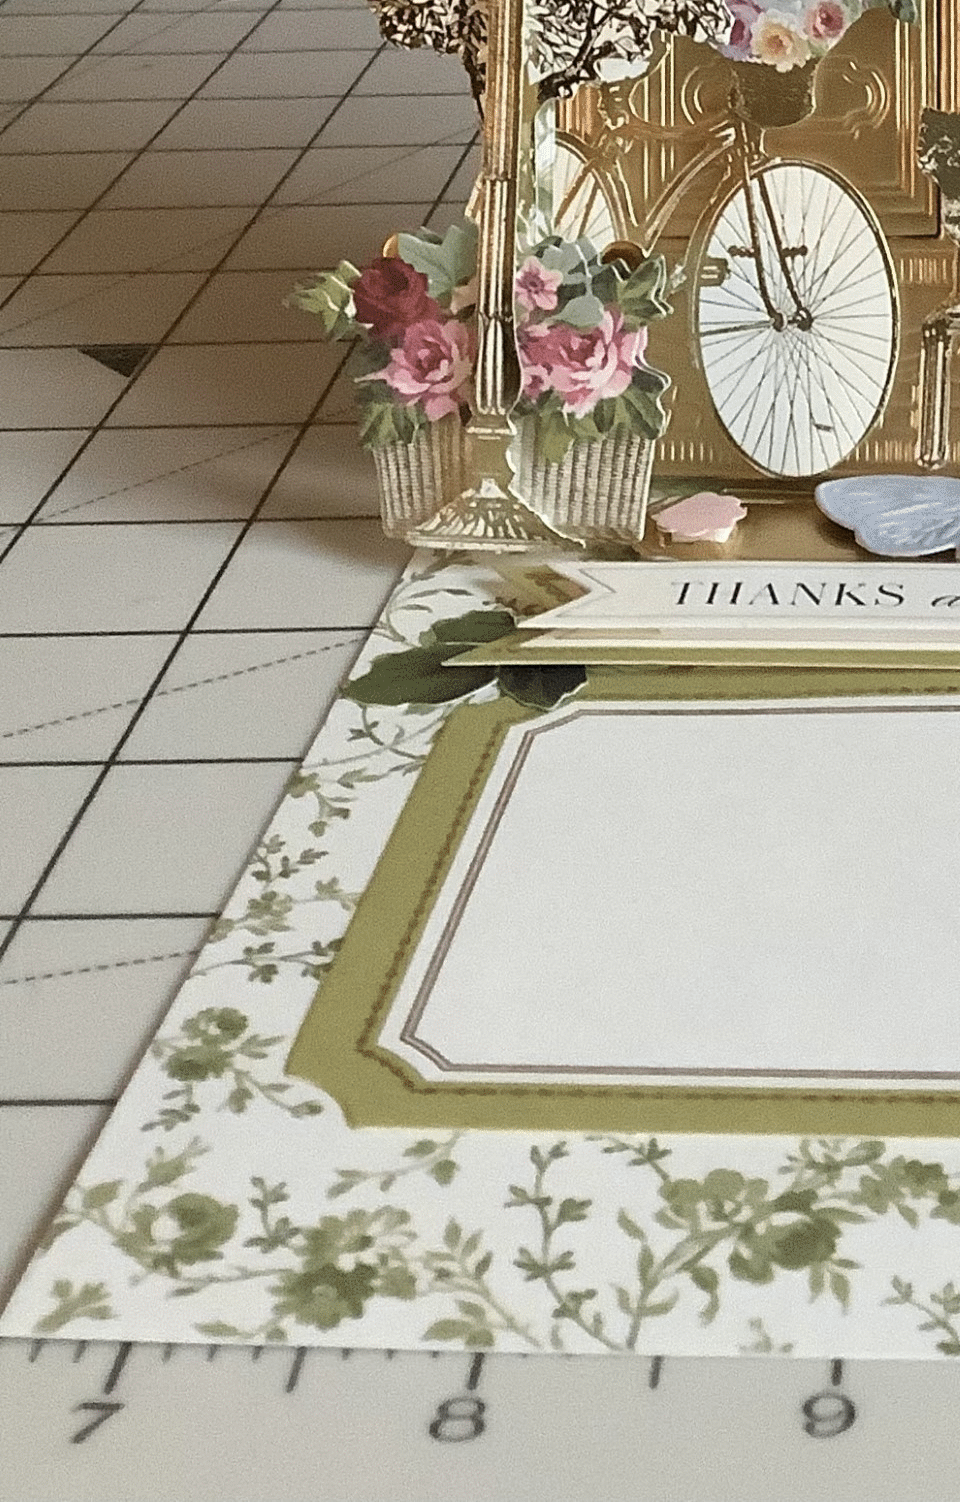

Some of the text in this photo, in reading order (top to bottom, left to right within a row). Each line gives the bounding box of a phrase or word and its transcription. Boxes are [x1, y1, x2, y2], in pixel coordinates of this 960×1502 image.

[672, 581, 905, 607] THANKS
[69, 1401, 125, 1444] 7
[428, 1397, 486, 1442] 8
[801, 1392, 857, 1438] 9
